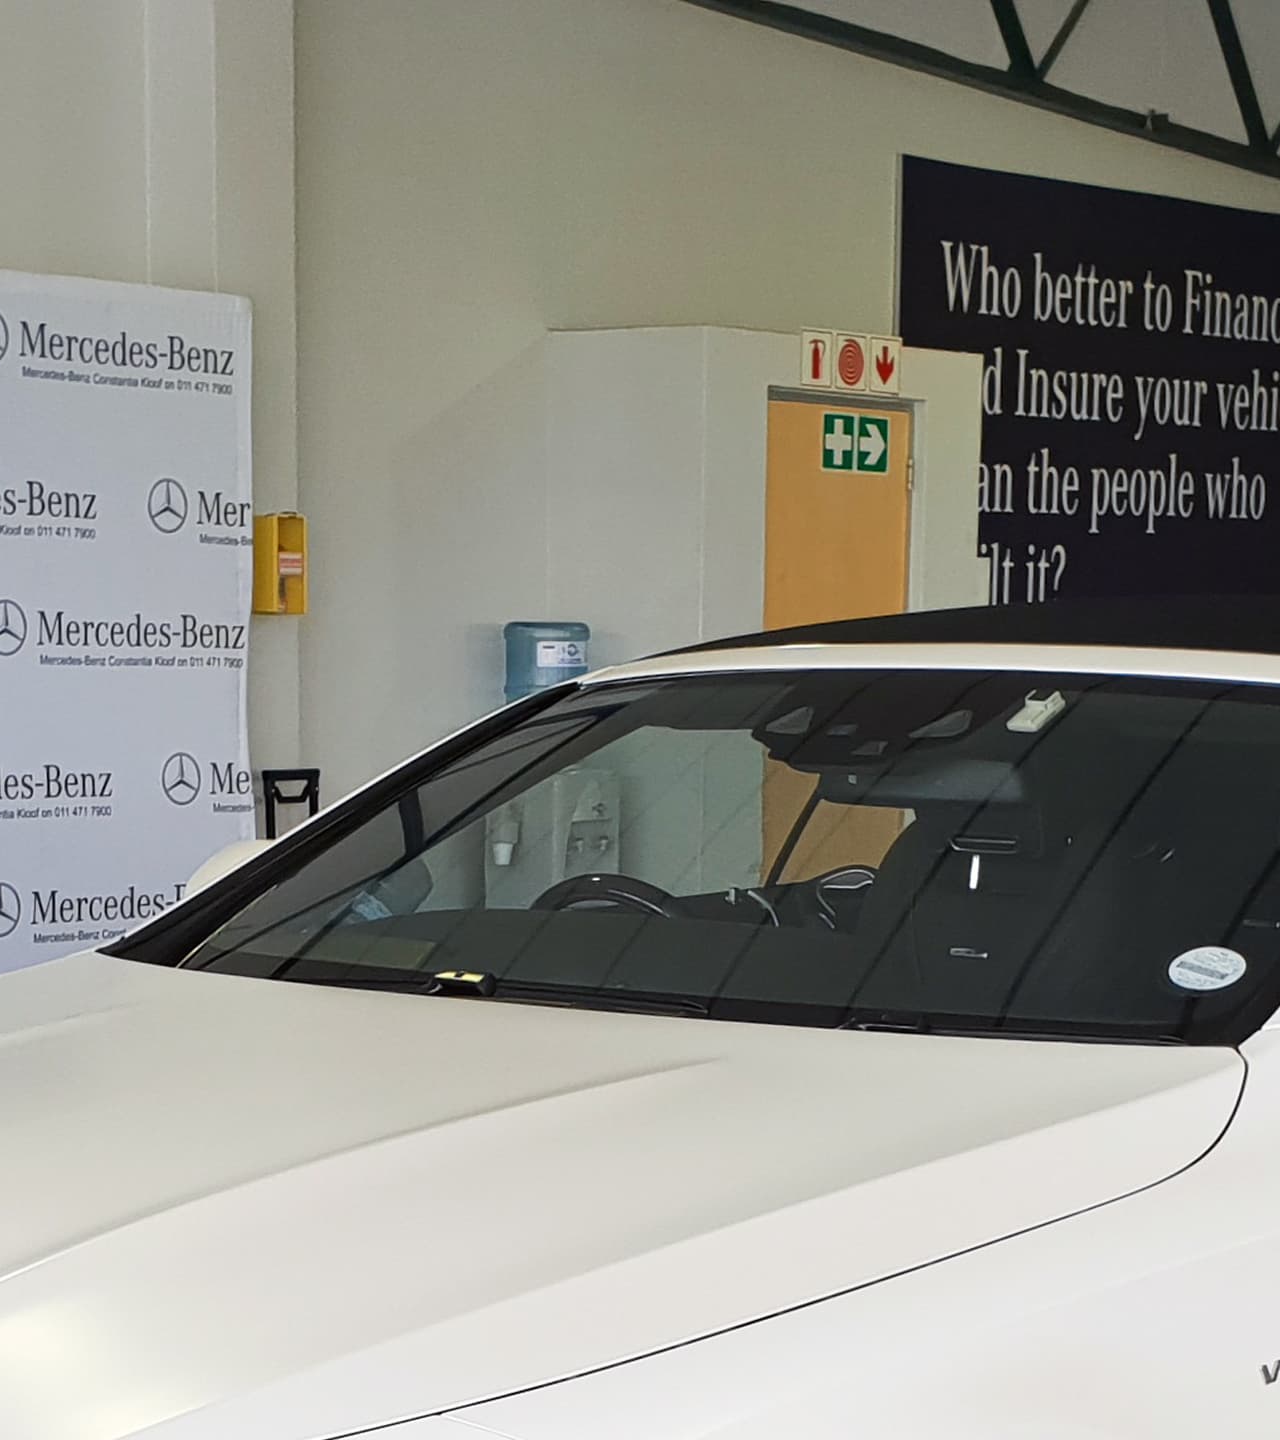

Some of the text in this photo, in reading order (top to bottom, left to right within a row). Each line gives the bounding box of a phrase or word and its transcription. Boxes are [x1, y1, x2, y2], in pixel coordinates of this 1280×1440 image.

[940, 240, 1021, 318] Who
[1033, 252, 1133, 329] better
[1144, 269, 1173, 332] to
[19, 321, 234, 376] Mercedes-Benz
[1014, 347, 1124, 423] Insure
[1134, 375, 1208, 440] your
[977, 447, 1267, 534] an the people who
[1025, 544, 1067, 604] it?
[37, 610, 245, 650] Mercedes-Benz
[30, 883, 186, 925] Mercedes-
